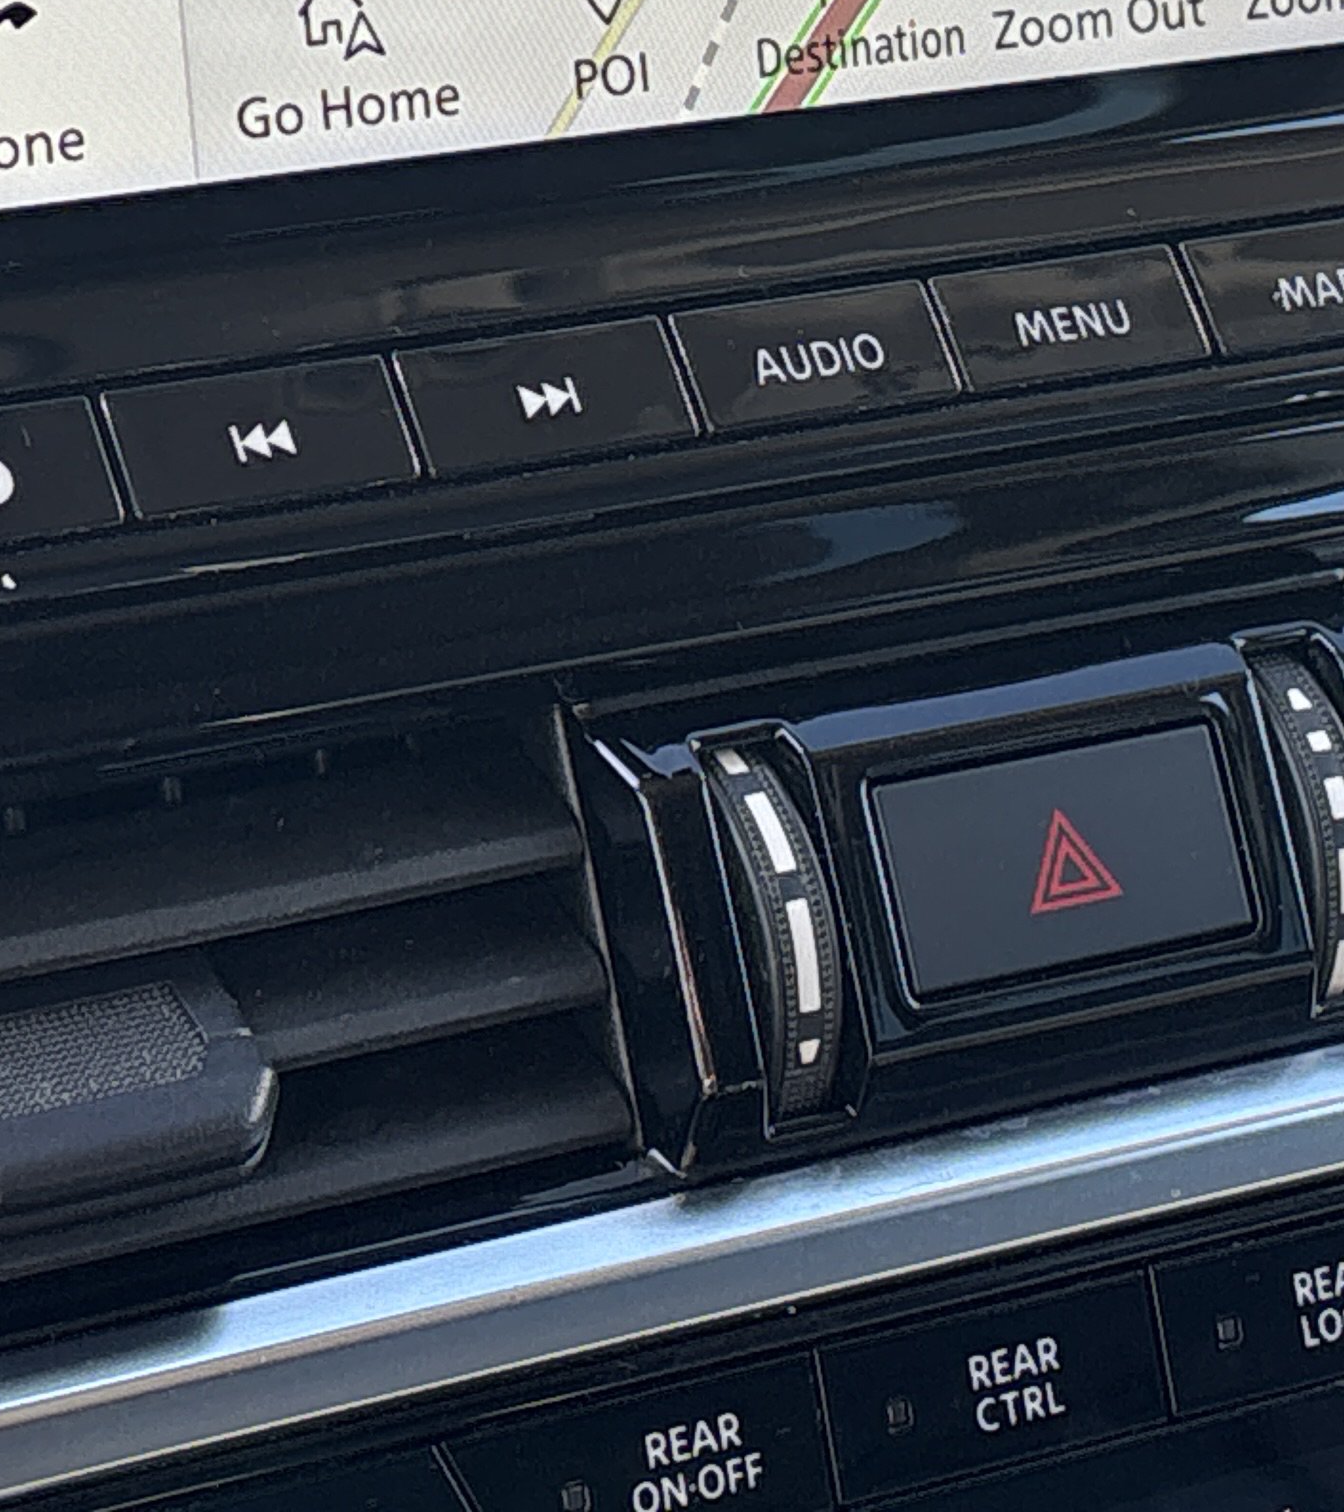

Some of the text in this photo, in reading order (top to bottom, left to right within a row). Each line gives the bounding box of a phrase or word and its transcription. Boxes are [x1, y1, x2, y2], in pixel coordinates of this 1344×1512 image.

[757, 18, 967, 81] Destination
[992, 0, 1113, 52] Zoom
[573, 53, 651, 100] POI
[236, 80, 462, 139] Go Home
[1015, 300, 1133, 347] MENU
[753, 331, 886, 386] AUDIO
[967, 1338, 1061, 1392] REAR
[974, 1383, 1066, 1434] CTRL
[644, 1412, 744, 1470] REAR
